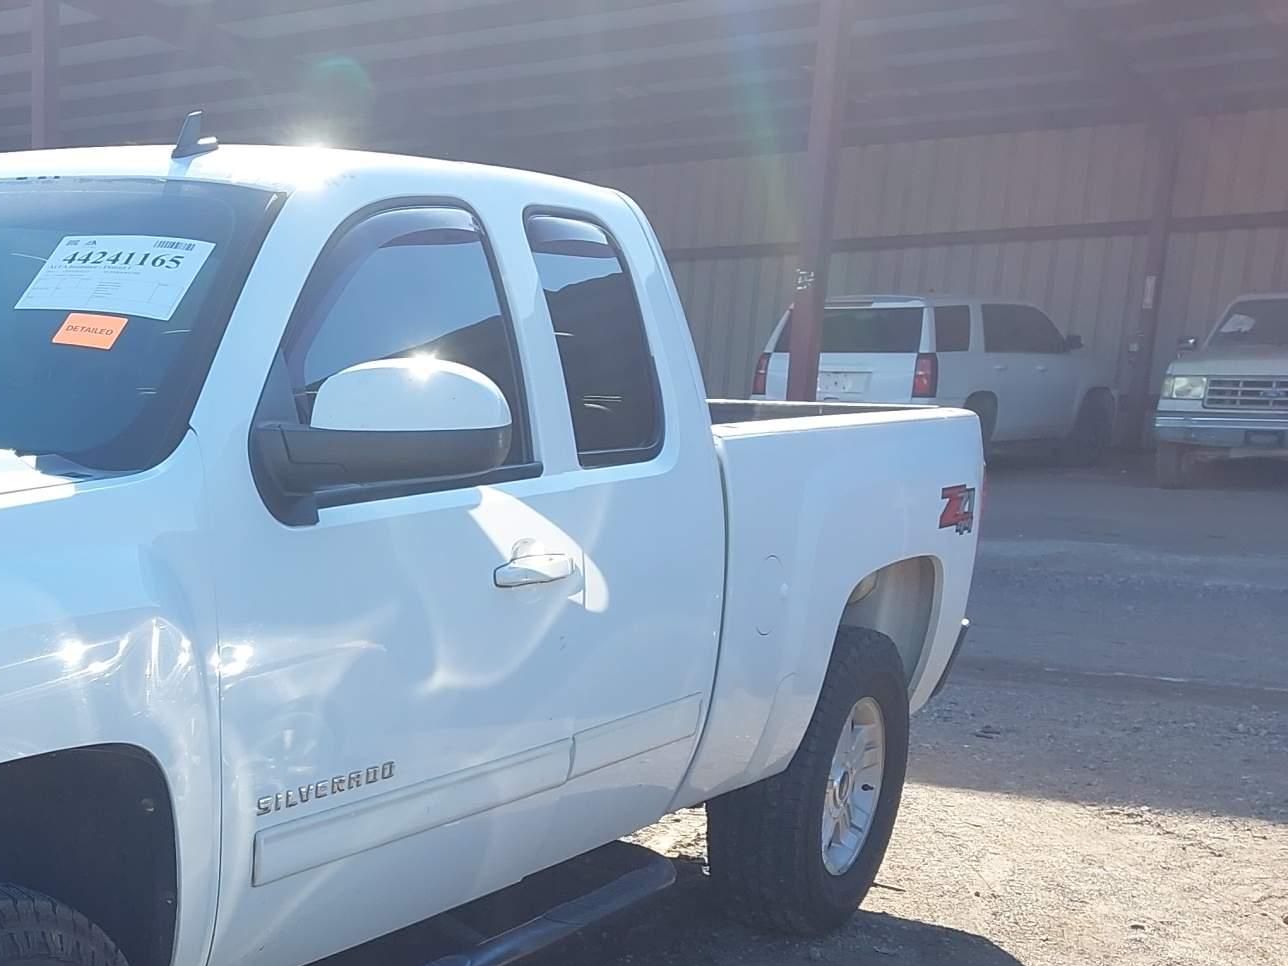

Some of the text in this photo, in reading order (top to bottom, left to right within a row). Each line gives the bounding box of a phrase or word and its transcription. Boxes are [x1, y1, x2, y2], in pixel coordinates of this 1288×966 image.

[62, 251, 185, 270] 44241165
[65, 324, 114, 336] DETAILED
[256, 761, 395, 817] SILVERADO
